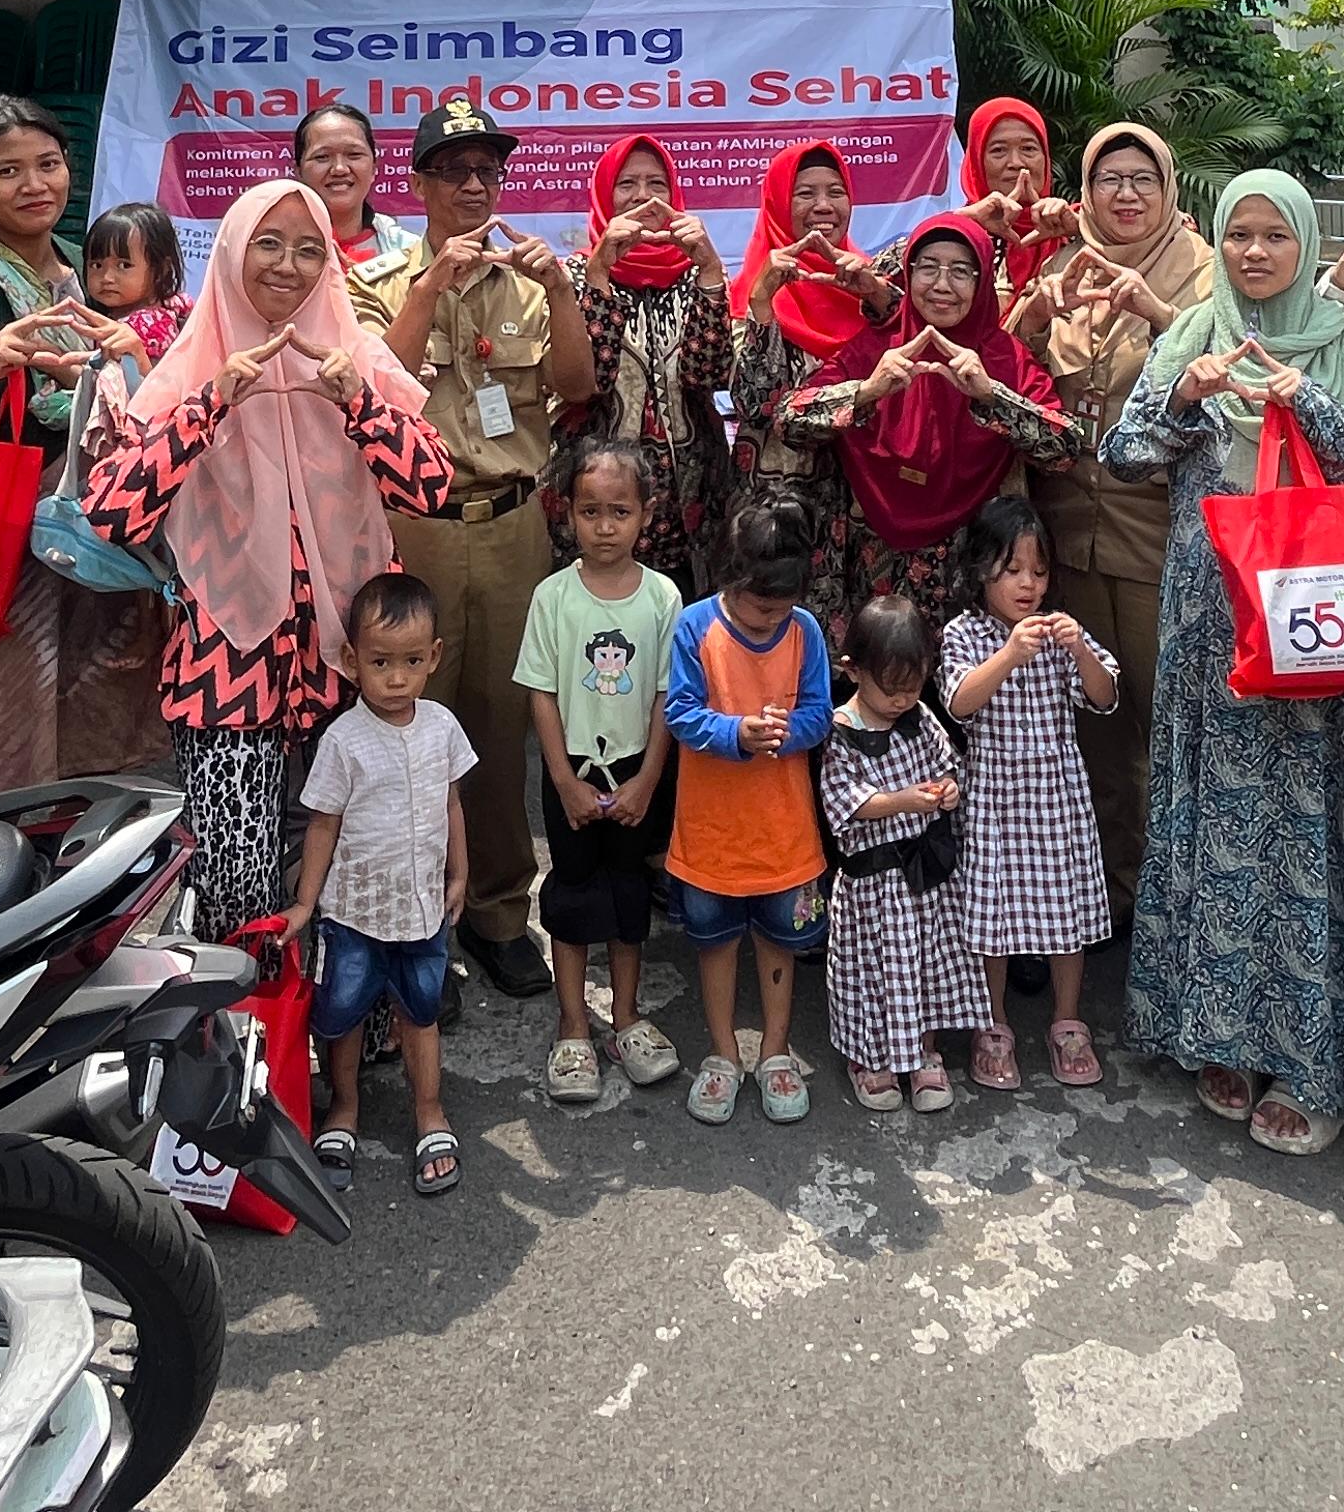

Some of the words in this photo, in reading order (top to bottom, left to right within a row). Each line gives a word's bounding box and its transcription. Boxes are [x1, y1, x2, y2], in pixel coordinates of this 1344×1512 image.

[168, 24, 288, 64] Gizi
[311, 21, 682, 64] Seimbang
[169, 78, 345, 118] Anak
[369, 70, 726, 115] Indonesia
[748, 66, 952, 106] Sehat
[571, 142, 611, 156] pilar
[829, 135, 893, 148] dengan
[186, 148, 278, 160] Komitmen
[186, 166, 282, 178] melakukan
[375, 181, 392, 193] di
[397, 181, 409, 193] 3
[532, 179, 582, 190] Astra
[700, 174, 752, 187] tahun
[186, 183, 234, 197] Sehat
